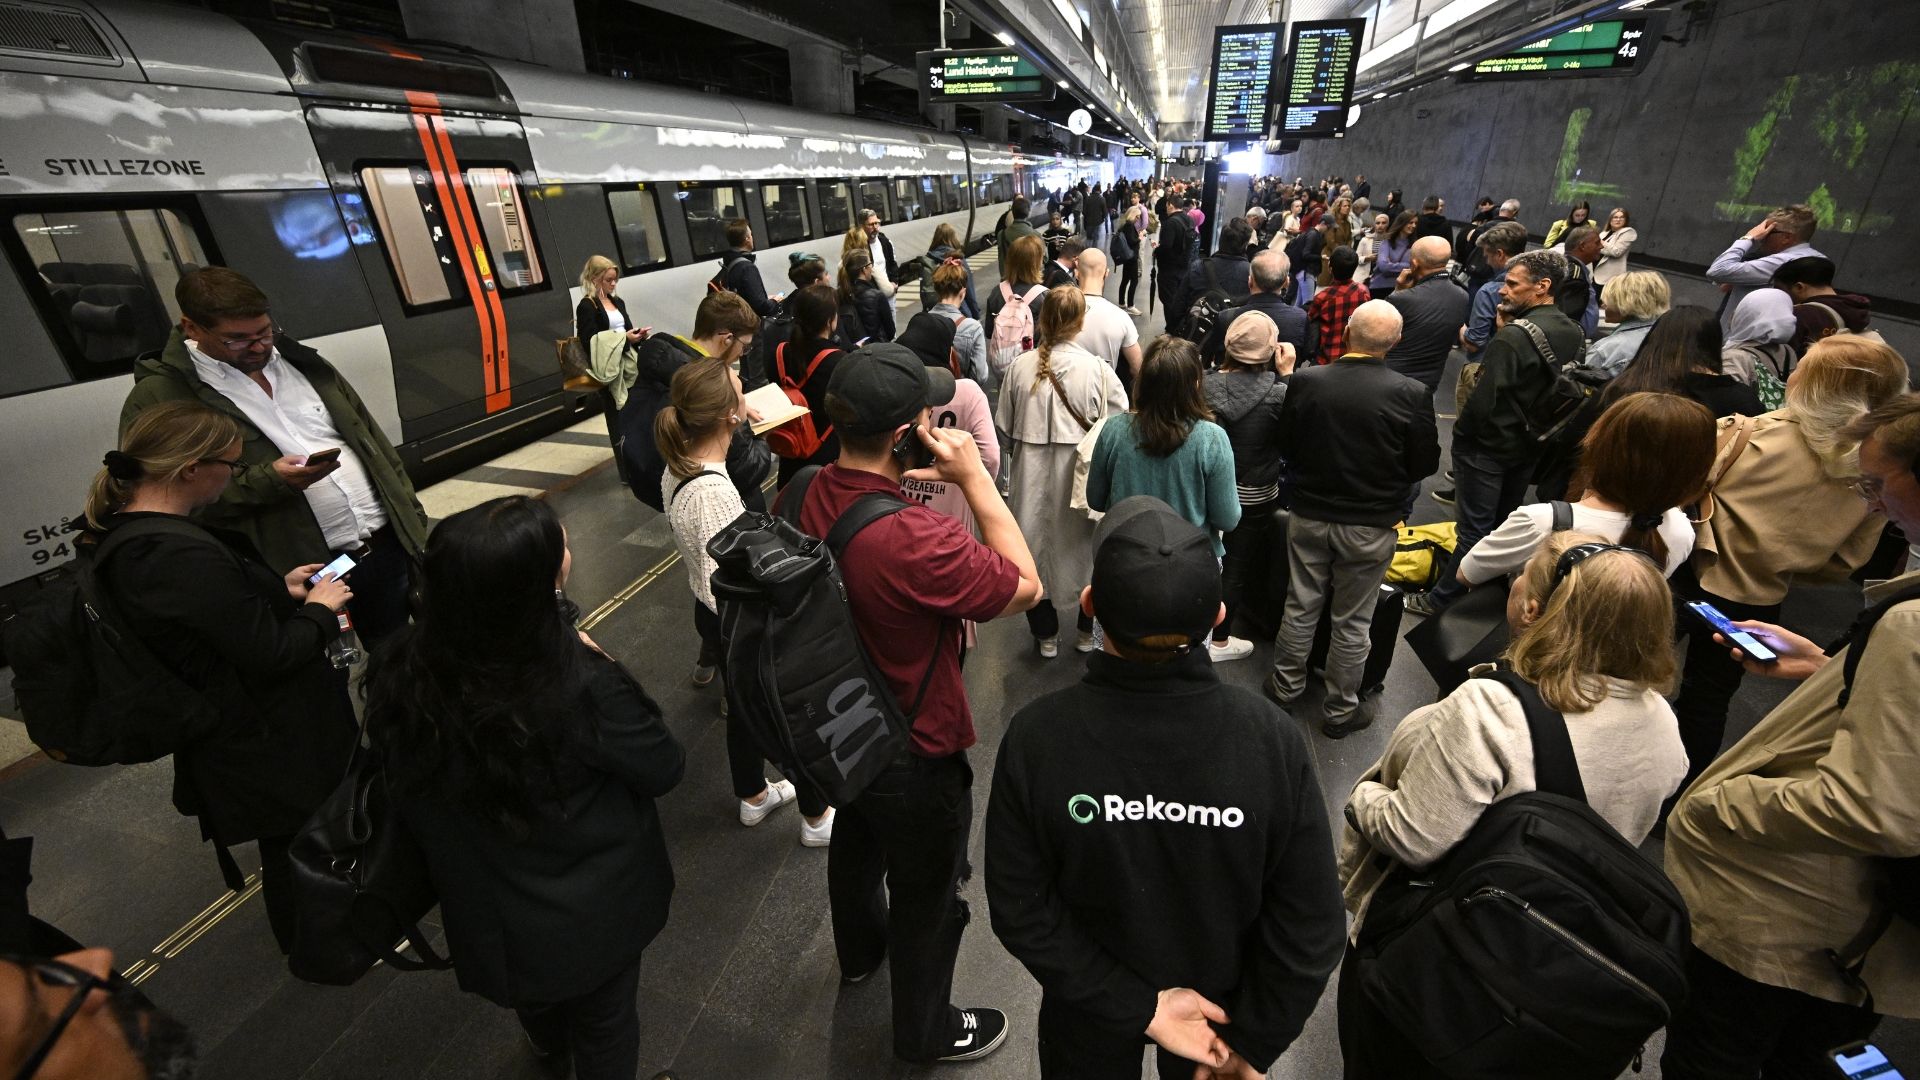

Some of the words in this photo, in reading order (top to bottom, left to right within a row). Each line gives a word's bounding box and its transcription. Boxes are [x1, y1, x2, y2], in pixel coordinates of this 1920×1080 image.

[1618, 43, 1638, 58] 4a
[944, 67, 964, 76] Lund
[965, 65, 1013, 76] Helsingborg
[930, 75, 943, 88] 3a
[44, 158, 206, 176] STILLEZONE
[1103, 794, 1244, 828] Rekomo
